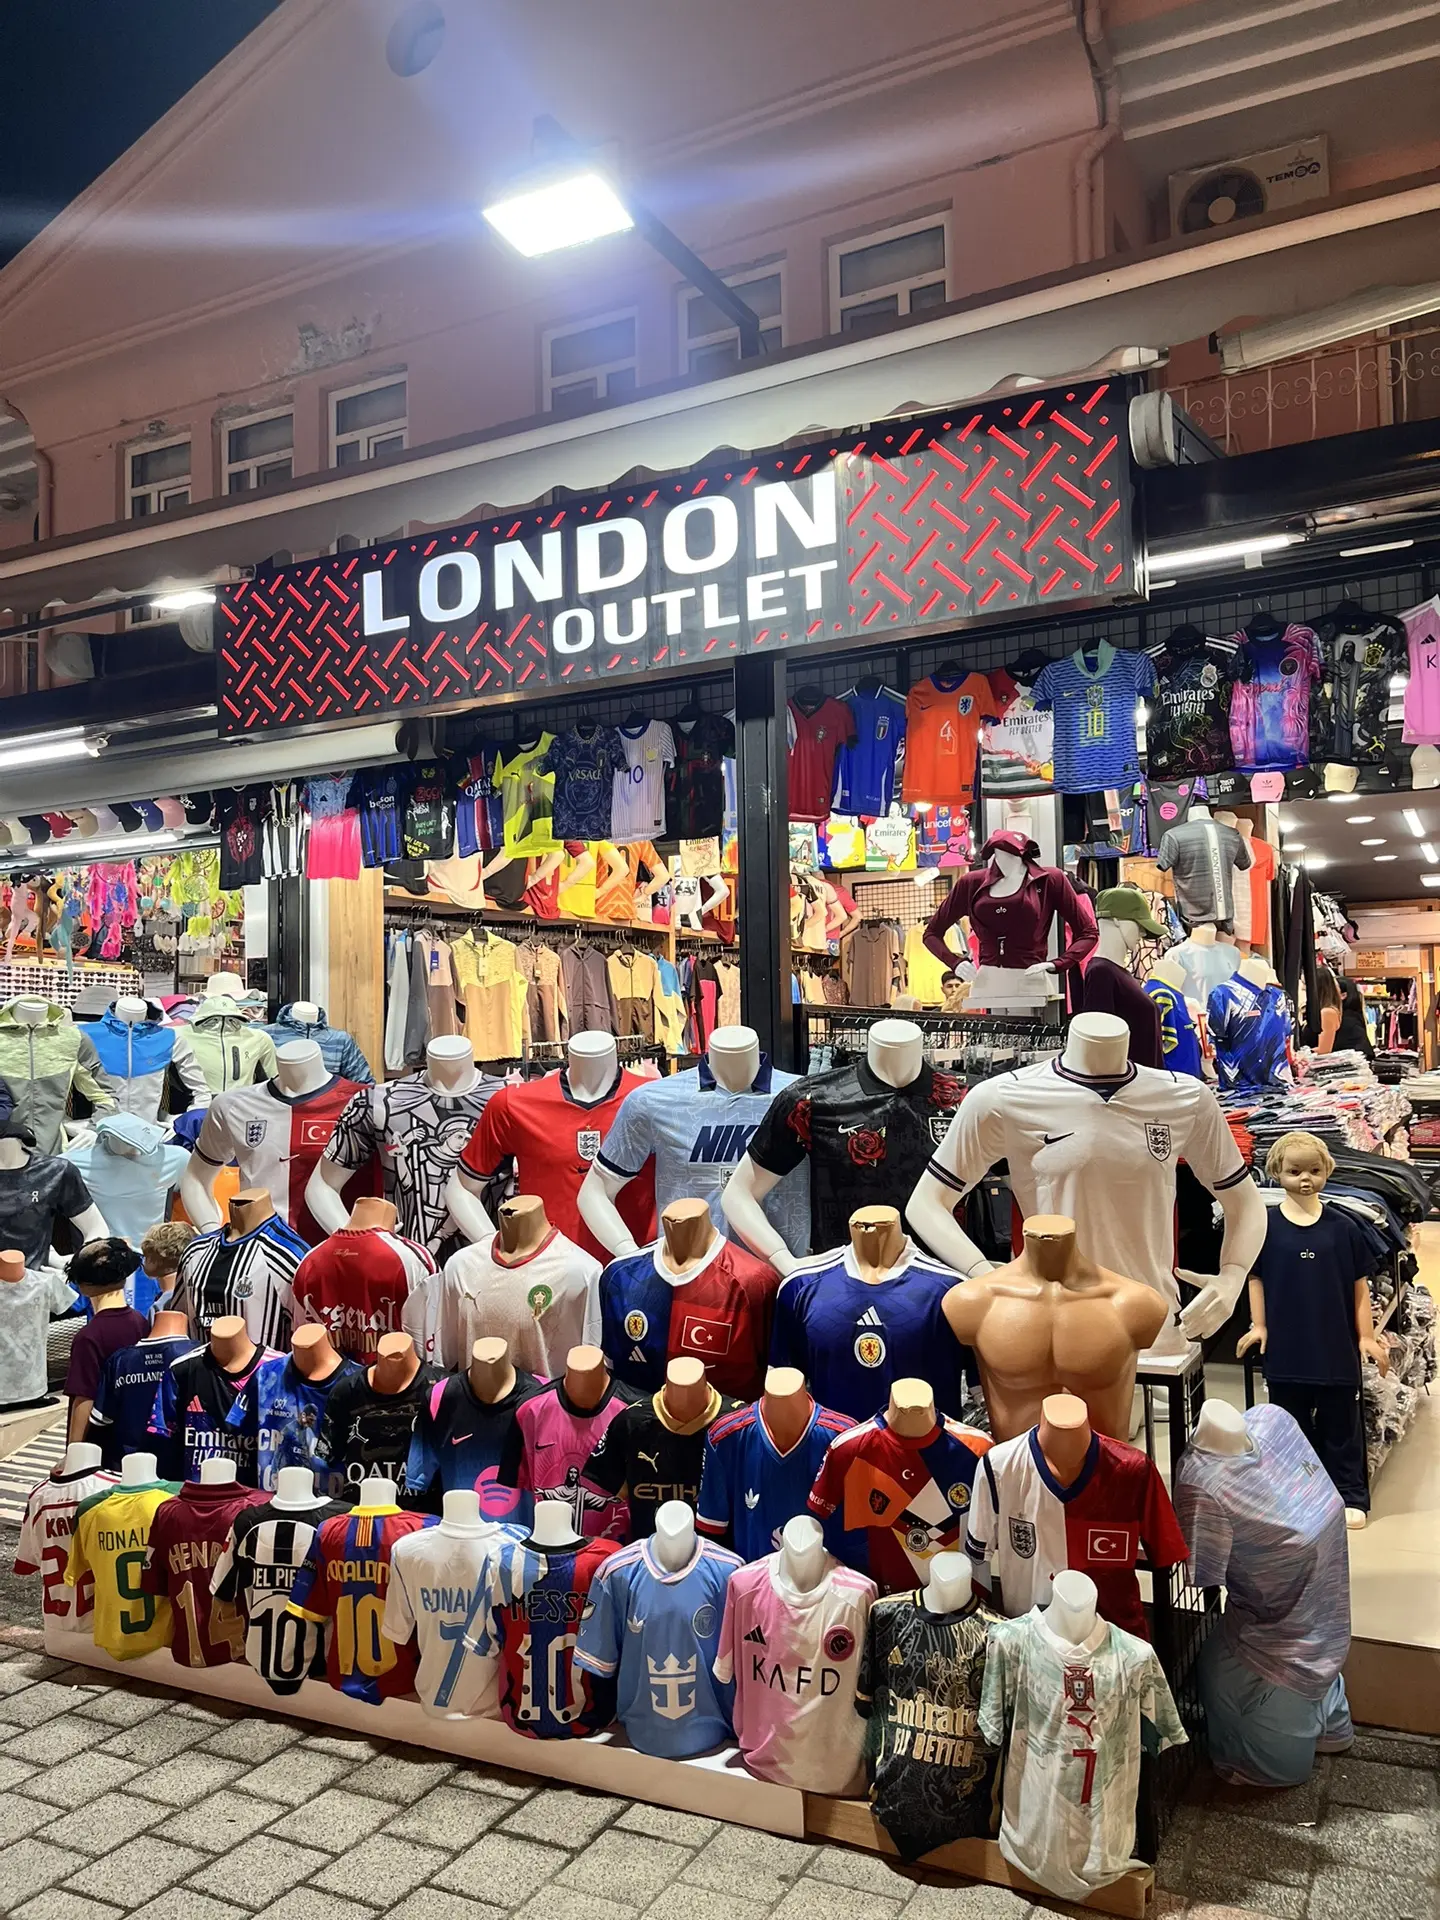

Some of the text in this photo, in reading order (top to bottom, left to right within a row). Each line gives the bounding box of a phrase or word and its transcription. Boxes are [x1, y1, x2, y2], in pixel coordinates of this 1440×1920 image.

[362, 471, 838, 636] LONDON
[551, 559, 838, 655] OUTLET
[1161, 688, 1215, 705] Emirates
[1003, 713, 1051, 727] Emirates
[1086, 708, 1104, 738] 10
[875, 829, 907, 837] Emirates
[923, 816, 952, 829] unicef
[689, 1125, 760, 1163] NIK
[1300, 1248, 1315, 1258] alo
[205, 1302, 224, 1314] AUF
[303, 1293, 397, 1332] Arsenal
[185, 1427, 258, 1451] Emirate
[347, 1461, 407, 1487] QATA
[633, 1483, 697, 1501] ETIH
[98, 1526, 148, 1551] RONAL
[168, 1540, 223, 1575] HENR
[115, 1551, 155, 1635] 9
[175, 1579, 246, 1668] 14
[336, 1593, 398, 1678] 10
[250, 1607, 307, 1680] 10
[516, 1633, 588, 1725] 10
[888, 1688, 979, 1738] Emirate
[912, 1732, 975, 1767] BETTER
[1072, 1748, 1098, 1804] 7
